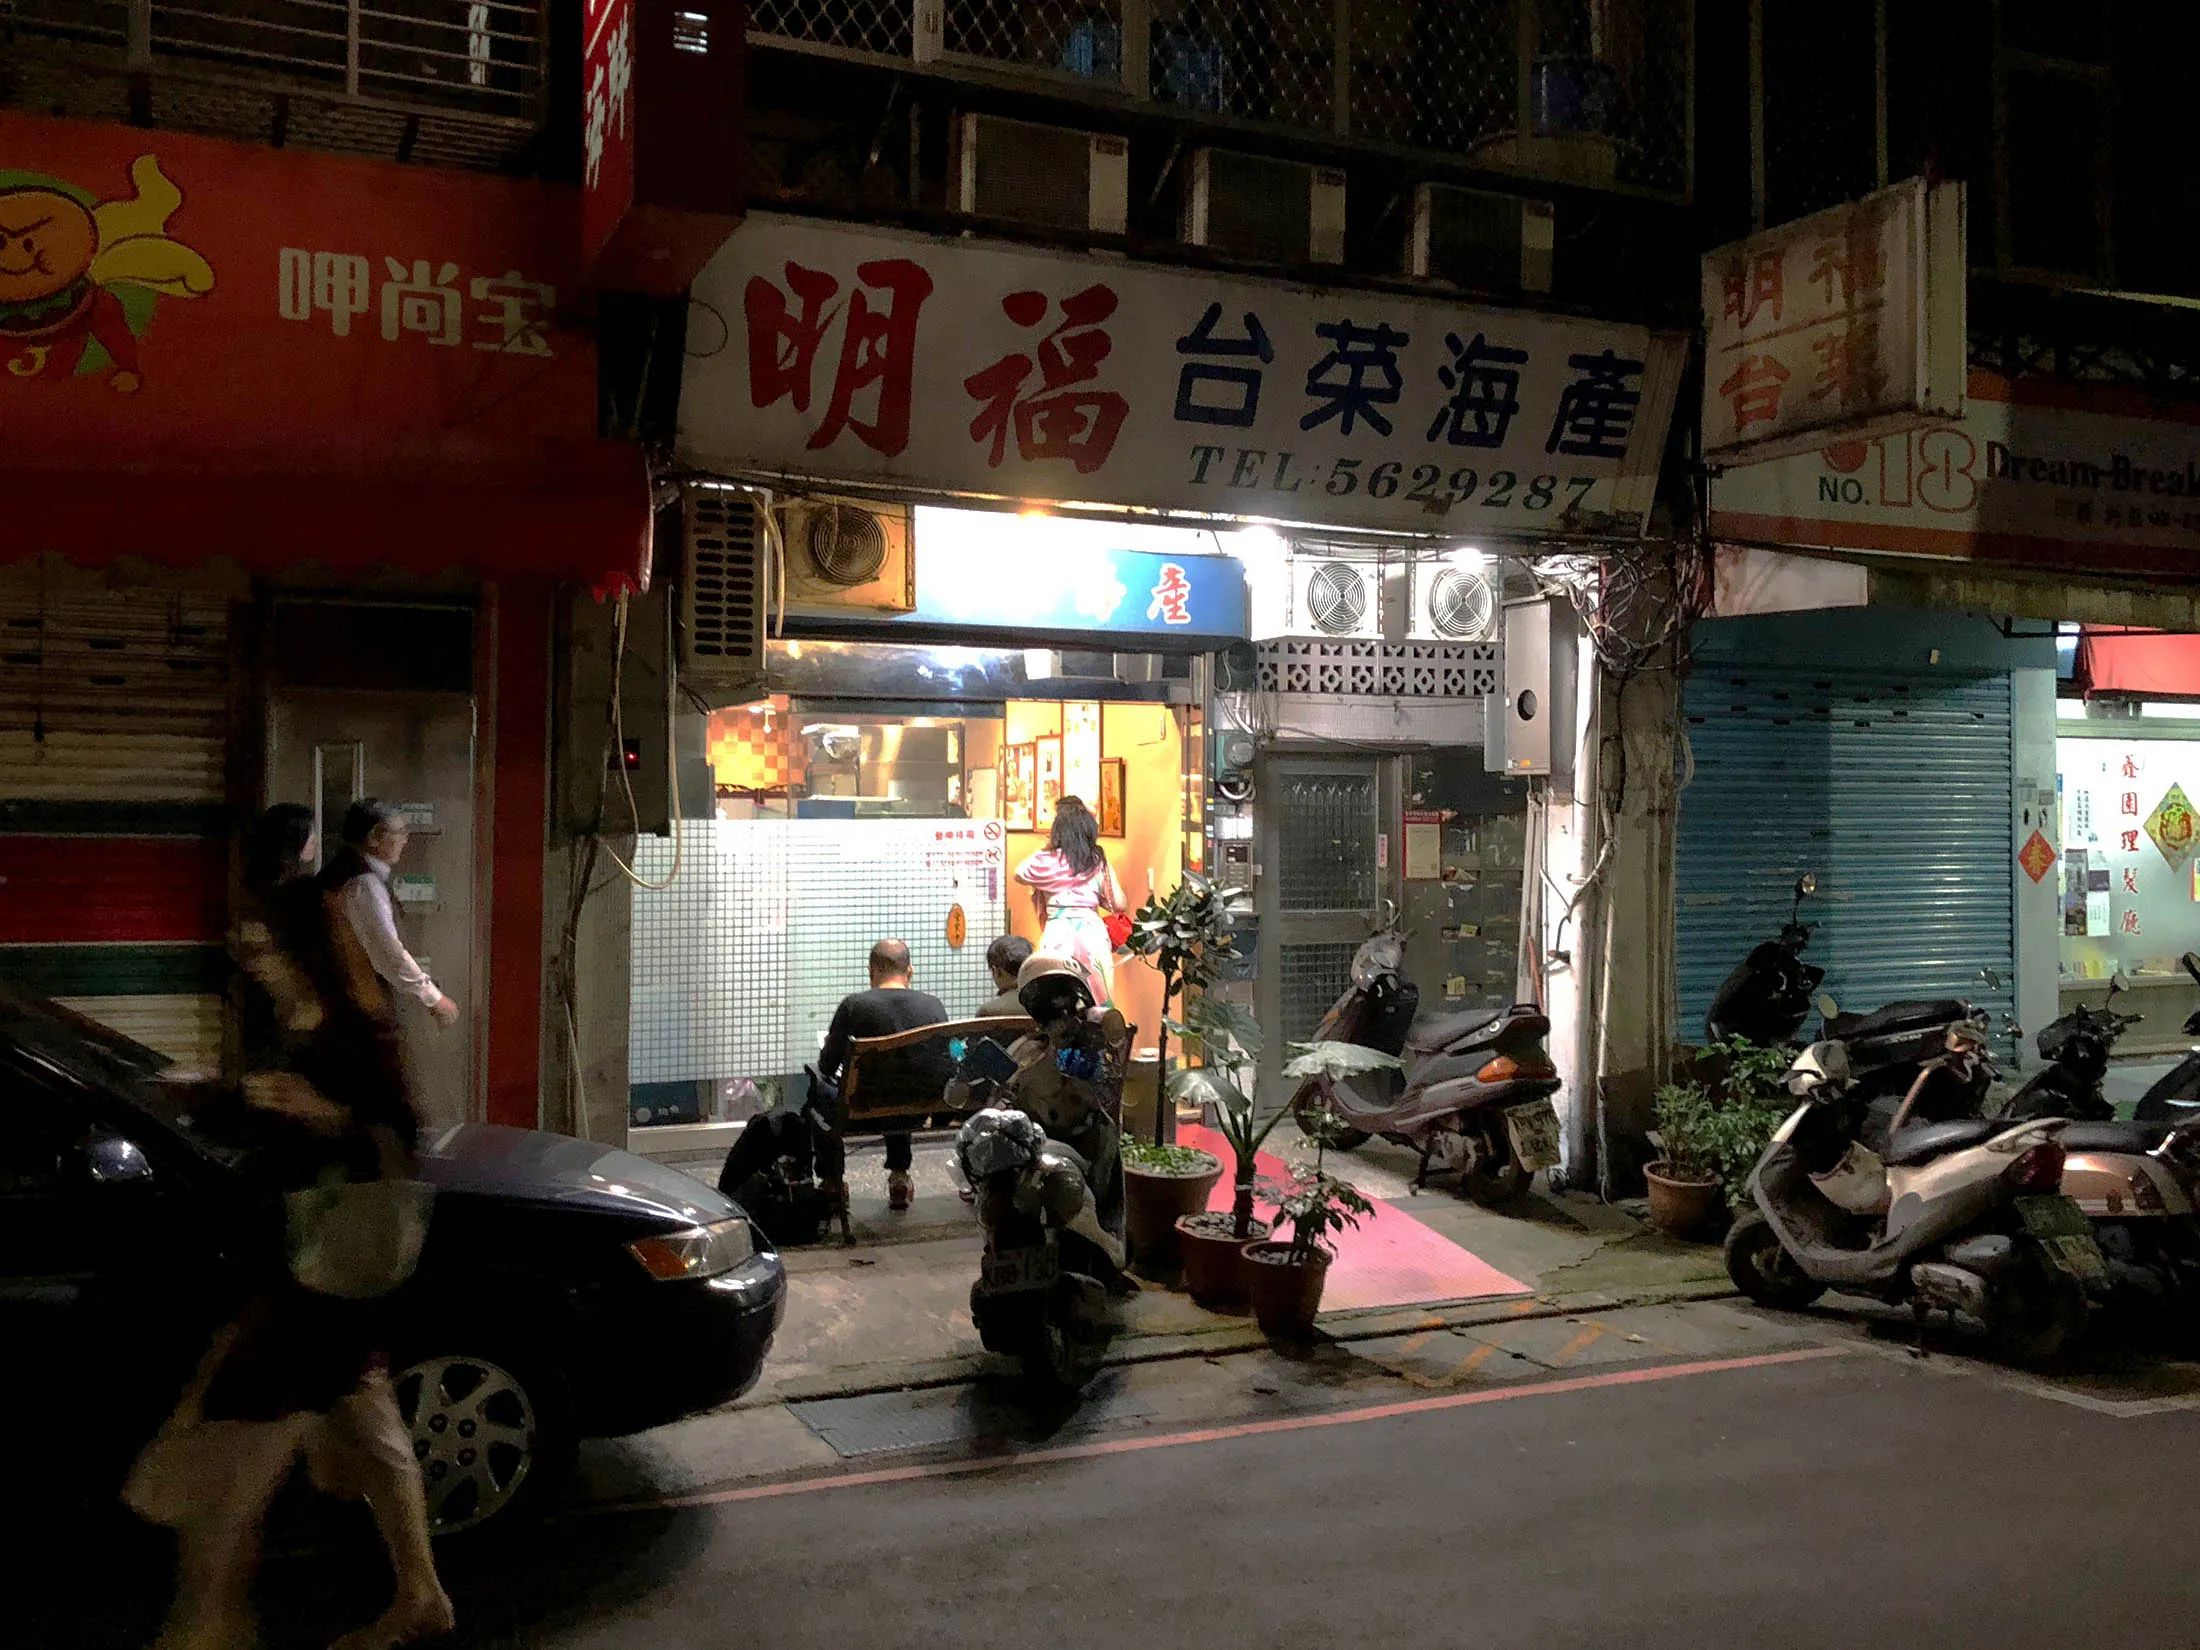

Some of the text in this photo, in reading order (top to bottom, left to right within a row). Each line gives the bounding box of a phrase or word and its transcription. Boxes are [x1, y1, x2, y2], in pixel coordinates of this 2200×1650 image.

[278, 246, 556, 358] 呷尚宝
[745, 260, 1132, 475] 明福
